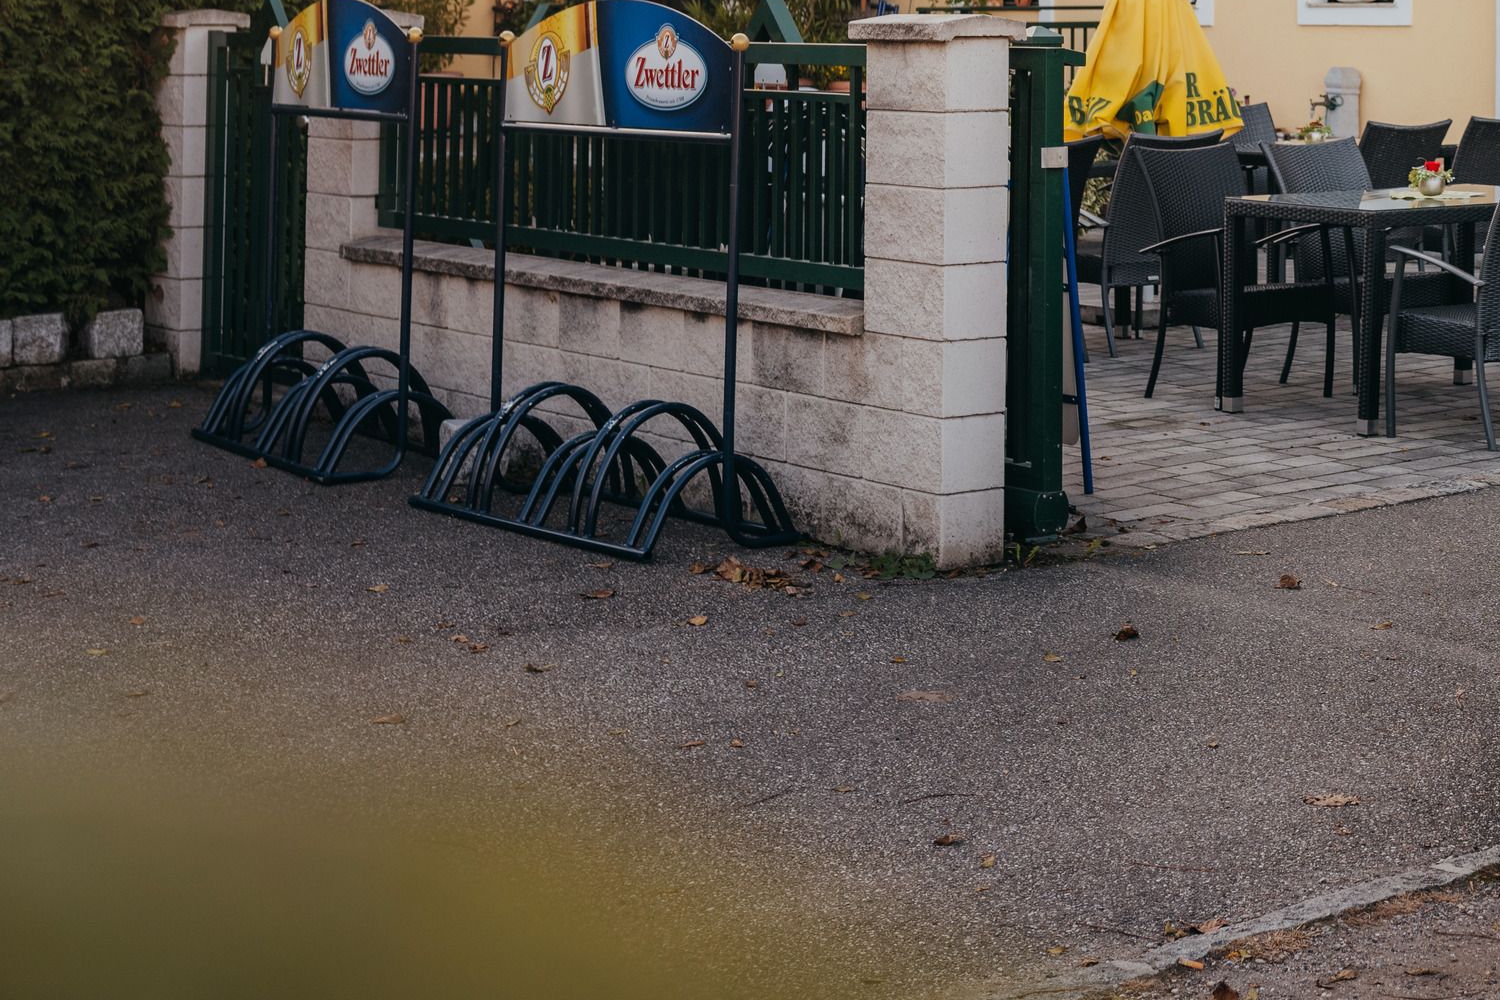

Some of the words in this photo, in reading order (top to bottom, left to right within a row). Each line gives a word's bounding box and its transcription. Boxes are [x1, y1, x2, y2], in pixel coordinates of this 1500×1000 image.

[295, 38, 302, 70] Z
[349, 48, 390, 77] Zwettler
[541, 44, 554, 83] Z
[634, 56, 699, 91] Zwettler
[1135, 109, 1153, 125] Da
